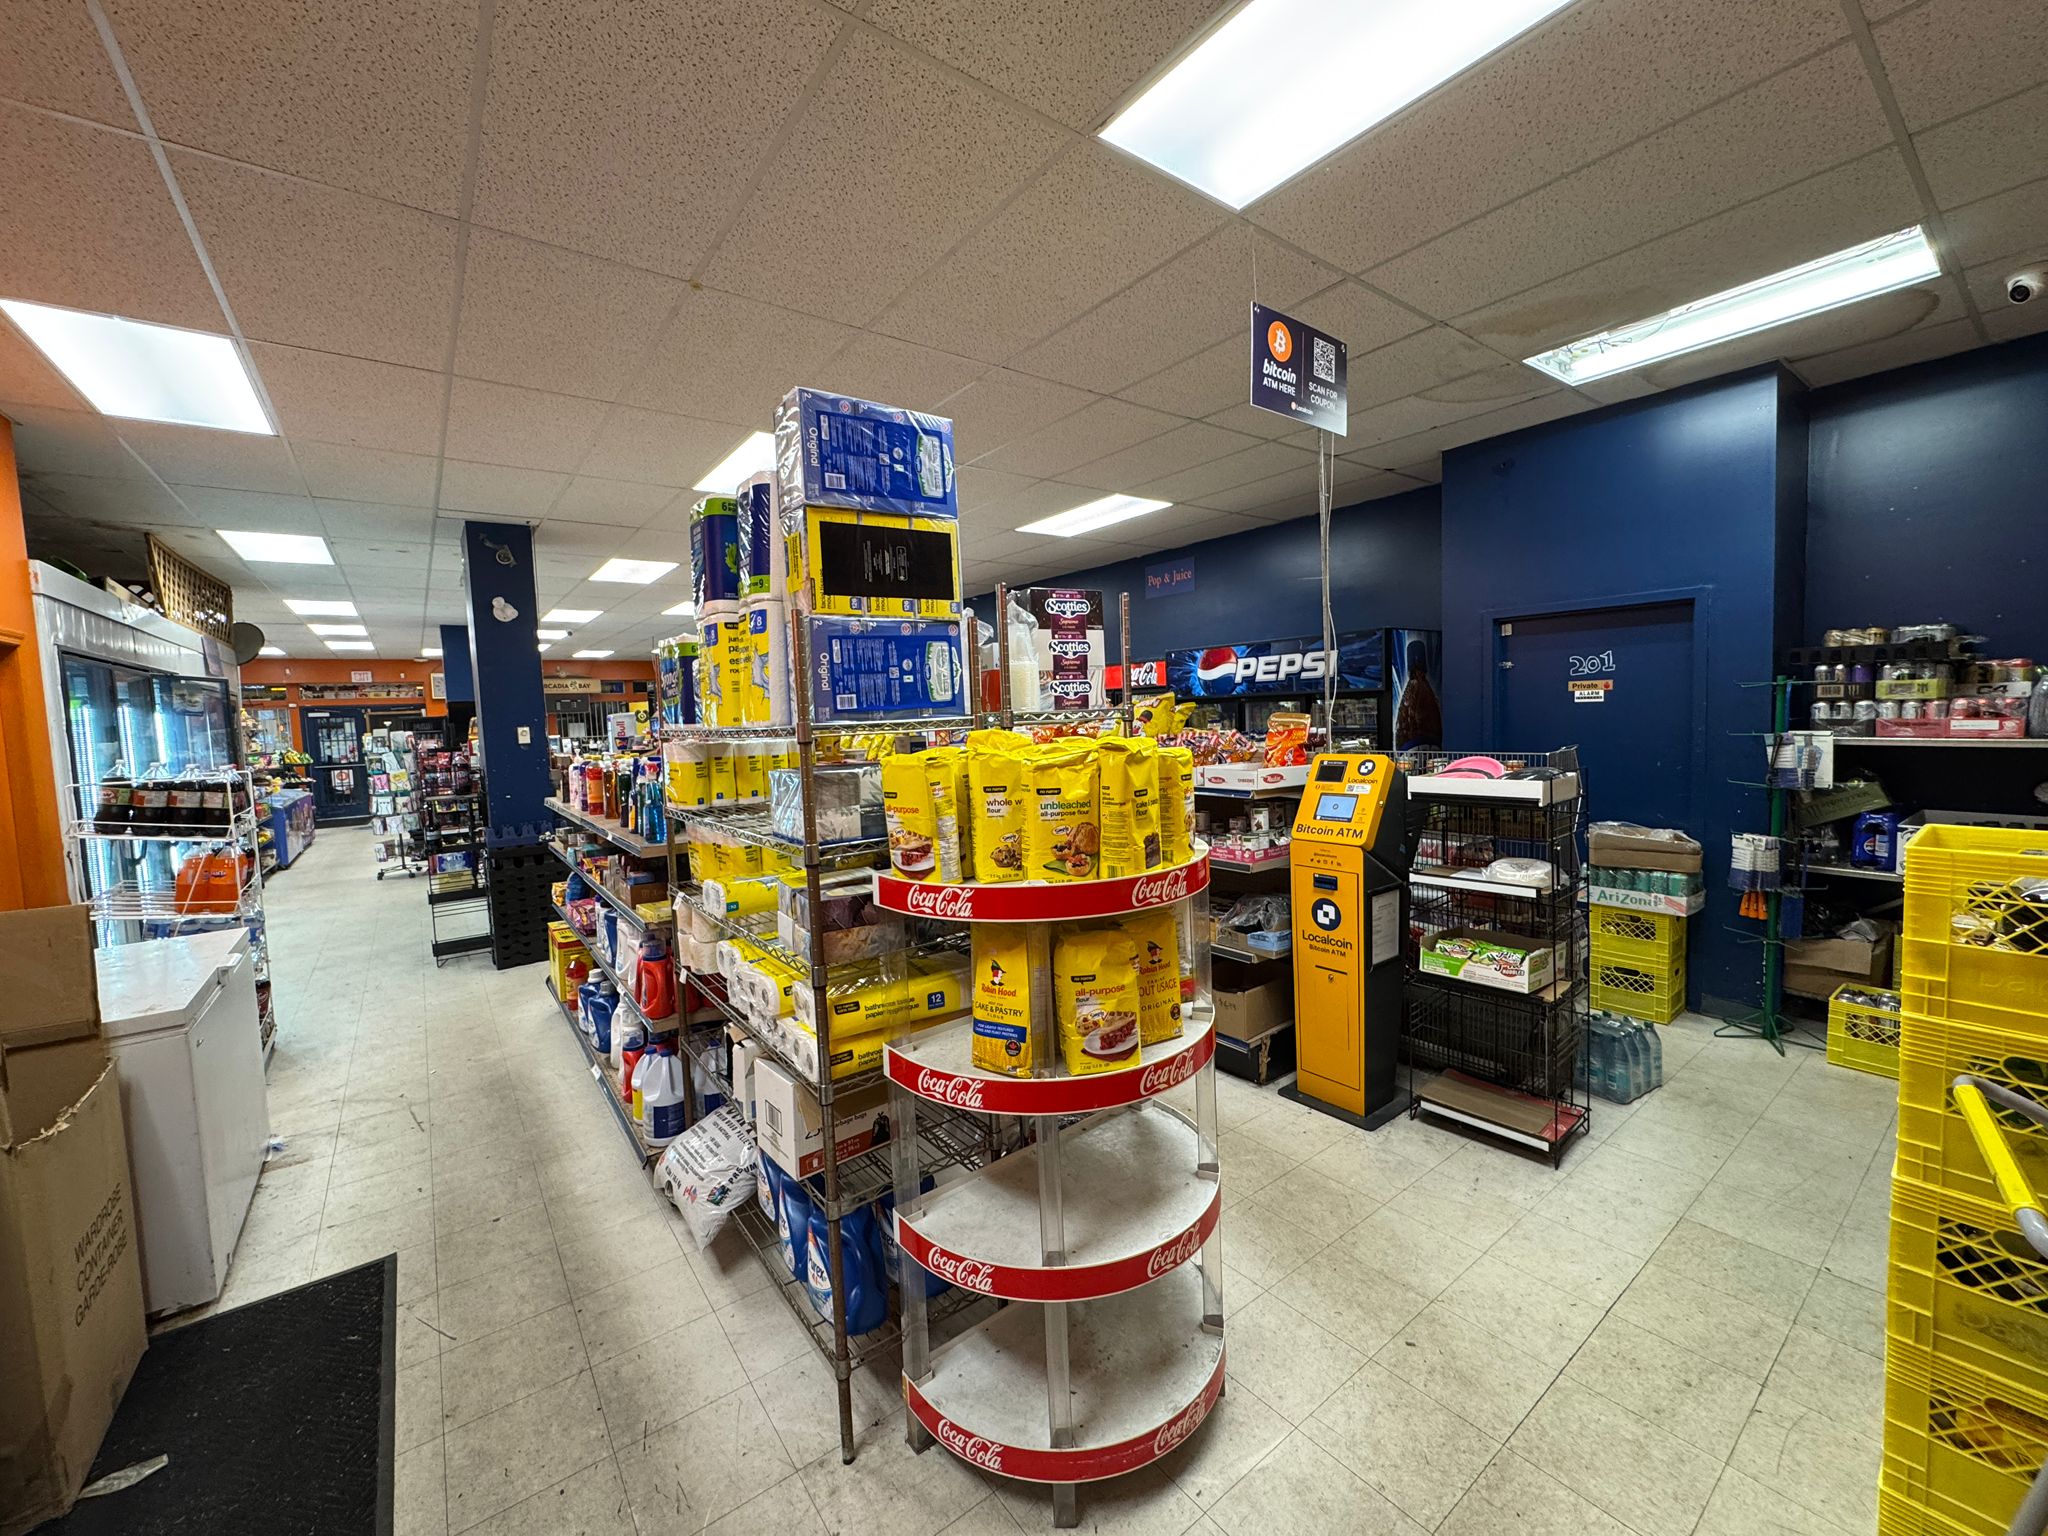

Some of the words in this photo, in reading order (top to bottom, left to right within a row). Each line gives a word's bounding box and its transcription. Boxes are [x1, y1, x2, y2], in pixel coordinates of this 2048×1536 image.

[1263, 358, 1297, 384] bitcoin
[1262, 377, 1279, 389] ATM
[1279, 382, 1296, 397] HERE
[1308, 382, 1326, 396] SCAN
[1326, 386, 1338, 400] FOR
[1310, 394, 1336, 410] COUPON
[806, 427, 821, 468] Original
[1148, 574, 1162, 588] Pop
[1171, 568, 1193, 585] Juice
[1049, 599, 1087, 614] Scotties
[756, 616, 762, 626] 8
[1051, 641, 1089, 655] Scotties
[818, 652, 831, 691] Original
[1235, 649, 1339, 684] PEPSI
[1569, 650, 1616, 676] 201
[1052, 680, 1090, 694] Scotties
[1572, 682, 1598, 690] Private
[986, 798, 1013, 806] whole
[1040, 800, 1091, 811] unbleached
[1295, 823, 1334, 837] Bitcoin
[1336, 827, 1364, 839] ATM
[1132, 868, 1188, 907] Coca-Cola
[907, 884, 973, 917] Coca-Cola
[1302, 929, 1353, 950] Localcoin
[1309, 943, 1330, 954] Bitcoin
[1331, 948, 1346, 957] ATM
[981, 983, 996, 995] Robin
[997, 987, 1017, 997] Hood
[1075, 984, 1126, 997] all-purpose
[1139, 984, 1155, 997] OUT
[1156, 978, 1178, 992] USAGE
[931, 993, 942, 1003] 12
[1141, 997, 1175, 1011] ORIGINAL
[975, 1001, 989, 1012] CAKE
[994, 1006, 1024, 1017] PASTRY
[858, 1049, 884, 1060] bathroo
[1140, 1048, 1195, 1096] Coca-Cola
[917, 1068, 985, 1108] Coca-Cola
[835, 1117, 854, 1127] arbage
[74, 1182, 121, 1263] WARDROBE
[76, 1209, 124, 1292] CONTAINER
[1147, 1221, 1200, 1279] Coca-Cola
[74, 1229, 128, 1328] GARDE-ROBE
[928, 1246, 994, 1292] Coca-Cola
[937, 1419, 1003, 1472] Coca-Cola
